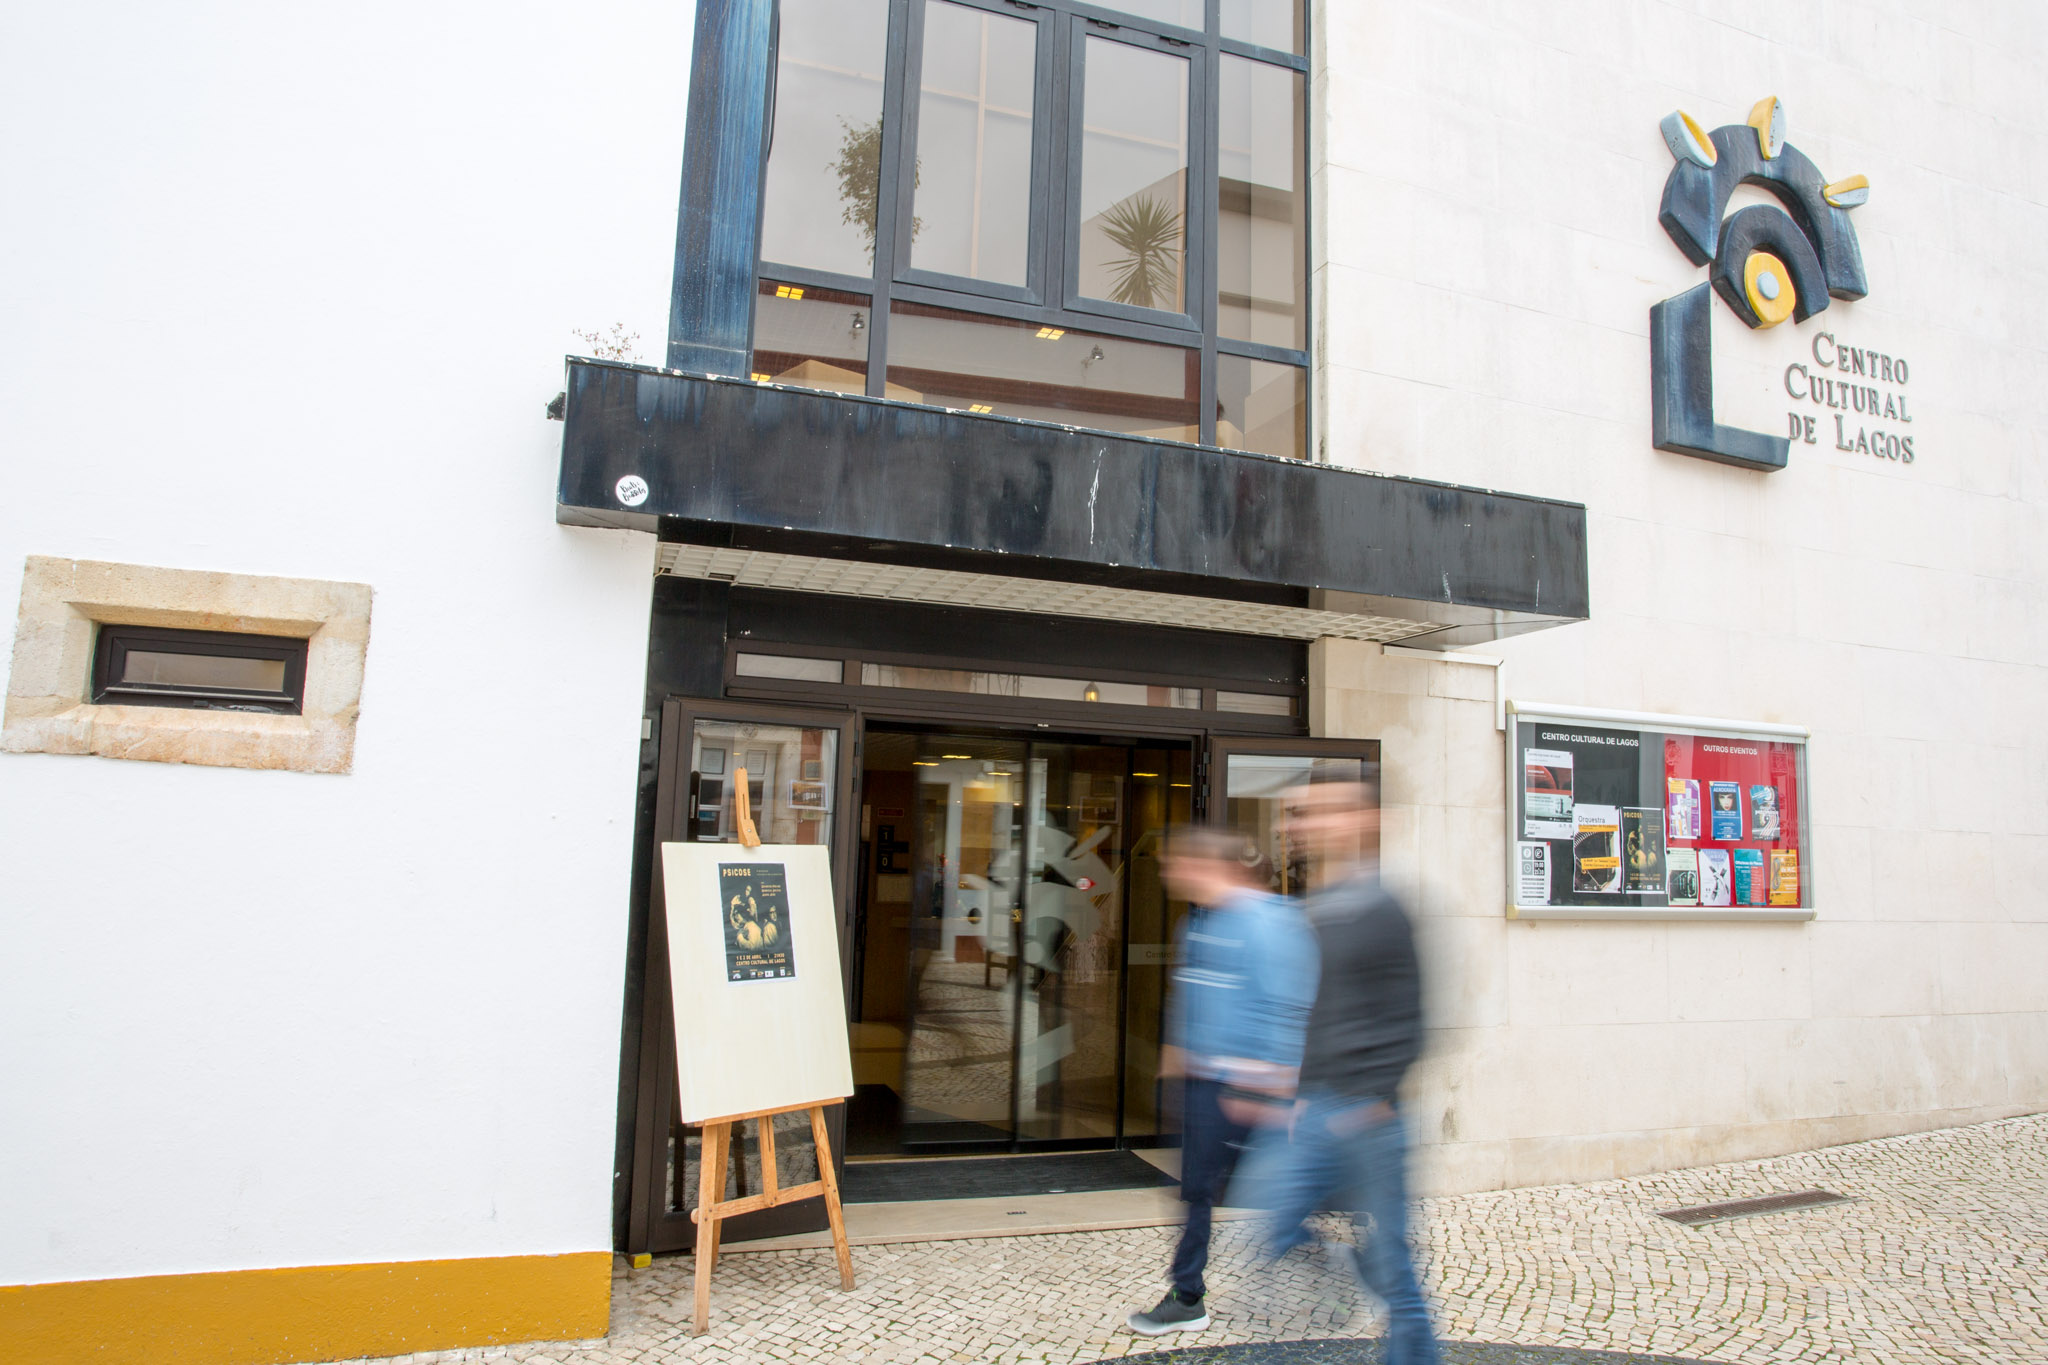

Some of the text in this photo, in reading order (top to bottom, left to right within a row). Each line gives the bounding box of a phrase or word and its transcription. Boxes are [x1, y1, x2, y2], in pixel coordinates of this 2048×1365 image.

[1541, 732, 1639, 747] CENTRO CULTURAL DE LAGOS
[1703, 744, 1758, 756] OUTROS EVENTOS
[1578, 815, 1605, 824] Orquestra
[722, 868, 751, 877] PSICOSE
